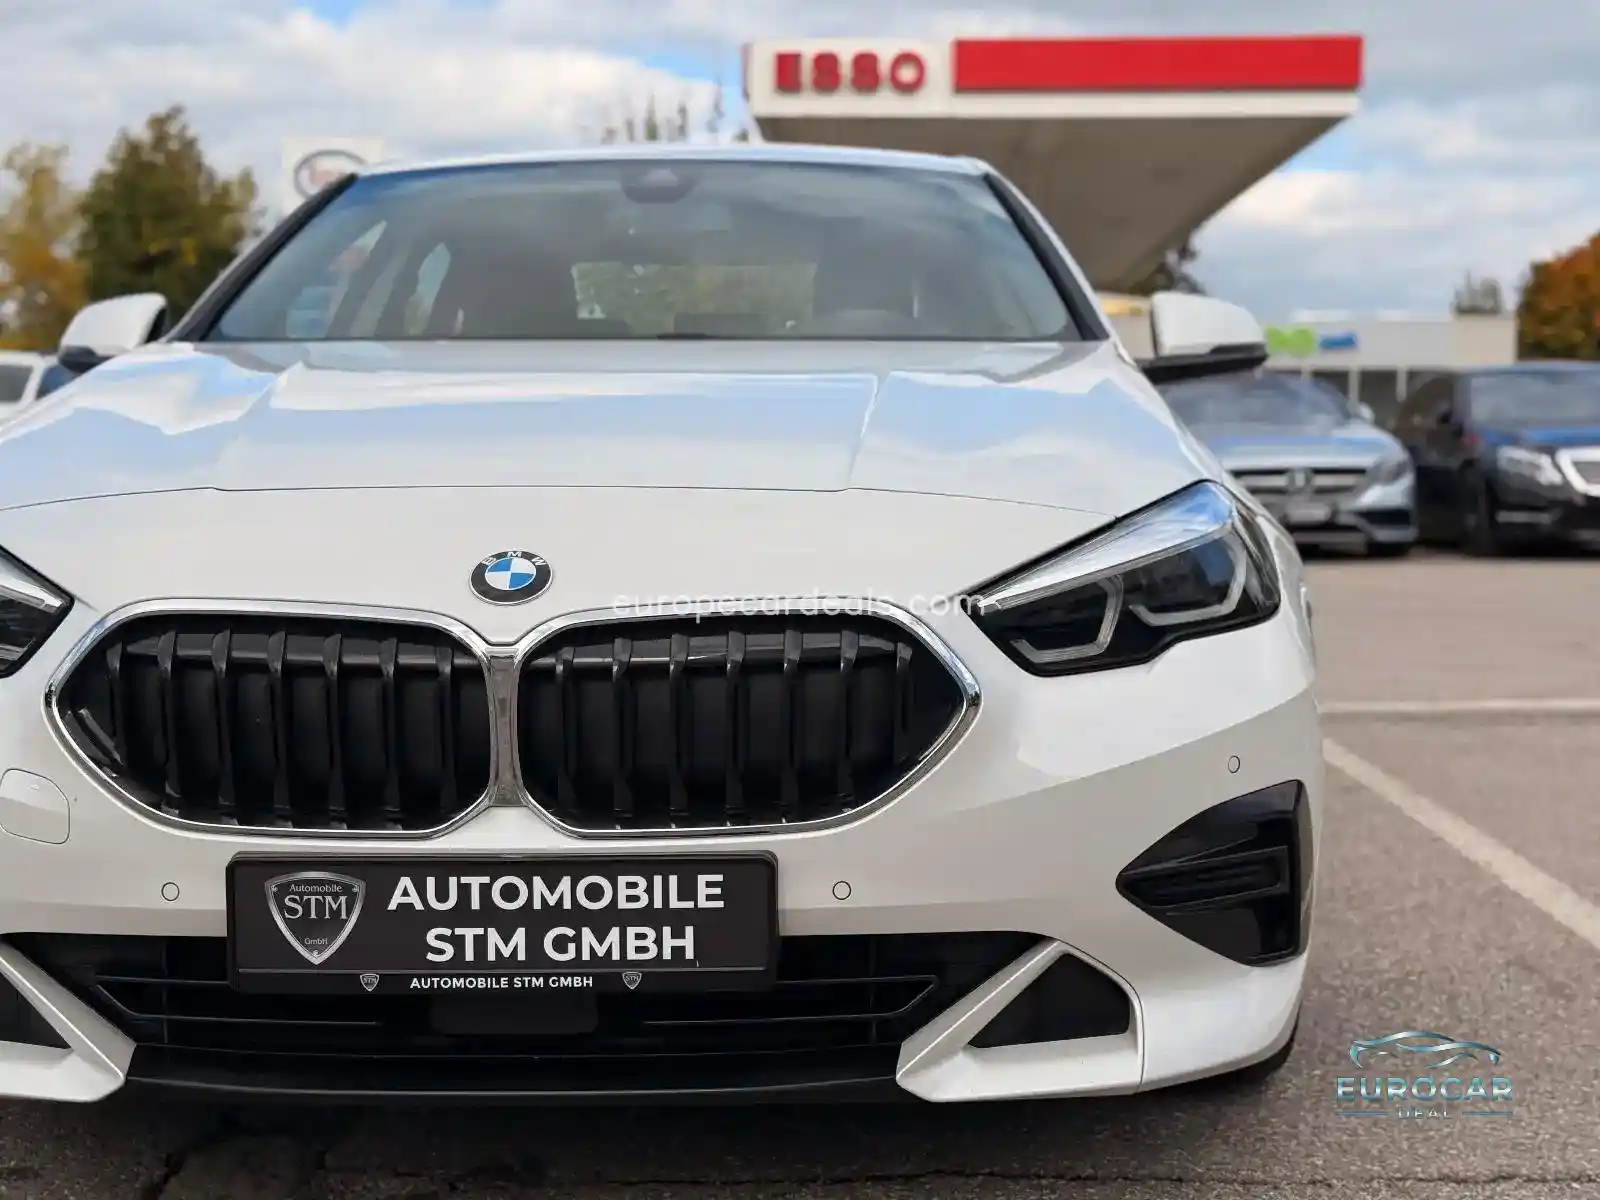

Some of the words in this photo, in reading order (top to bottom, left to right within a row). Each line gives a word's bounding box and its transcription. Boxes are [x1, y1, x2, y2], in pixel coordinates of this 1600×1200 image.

[775, 51, 926, 94] ESSO
[482, 551, 547, 566] BMW
[289, 884, 343, 893] Automobile
[387, 874, 725, 910] AUTOMOBILE
[283, 894, 349, 920] STM
[304, 937, 329, 945] GmbH
[425, 927, 526, 962] STM
[543, 925, 695, 962] GMBH
[409, 977, 509, 989] AUTOMOBILE
[513, 976, 544, 988] STM
[548, 976, 593, 988] GMBH
